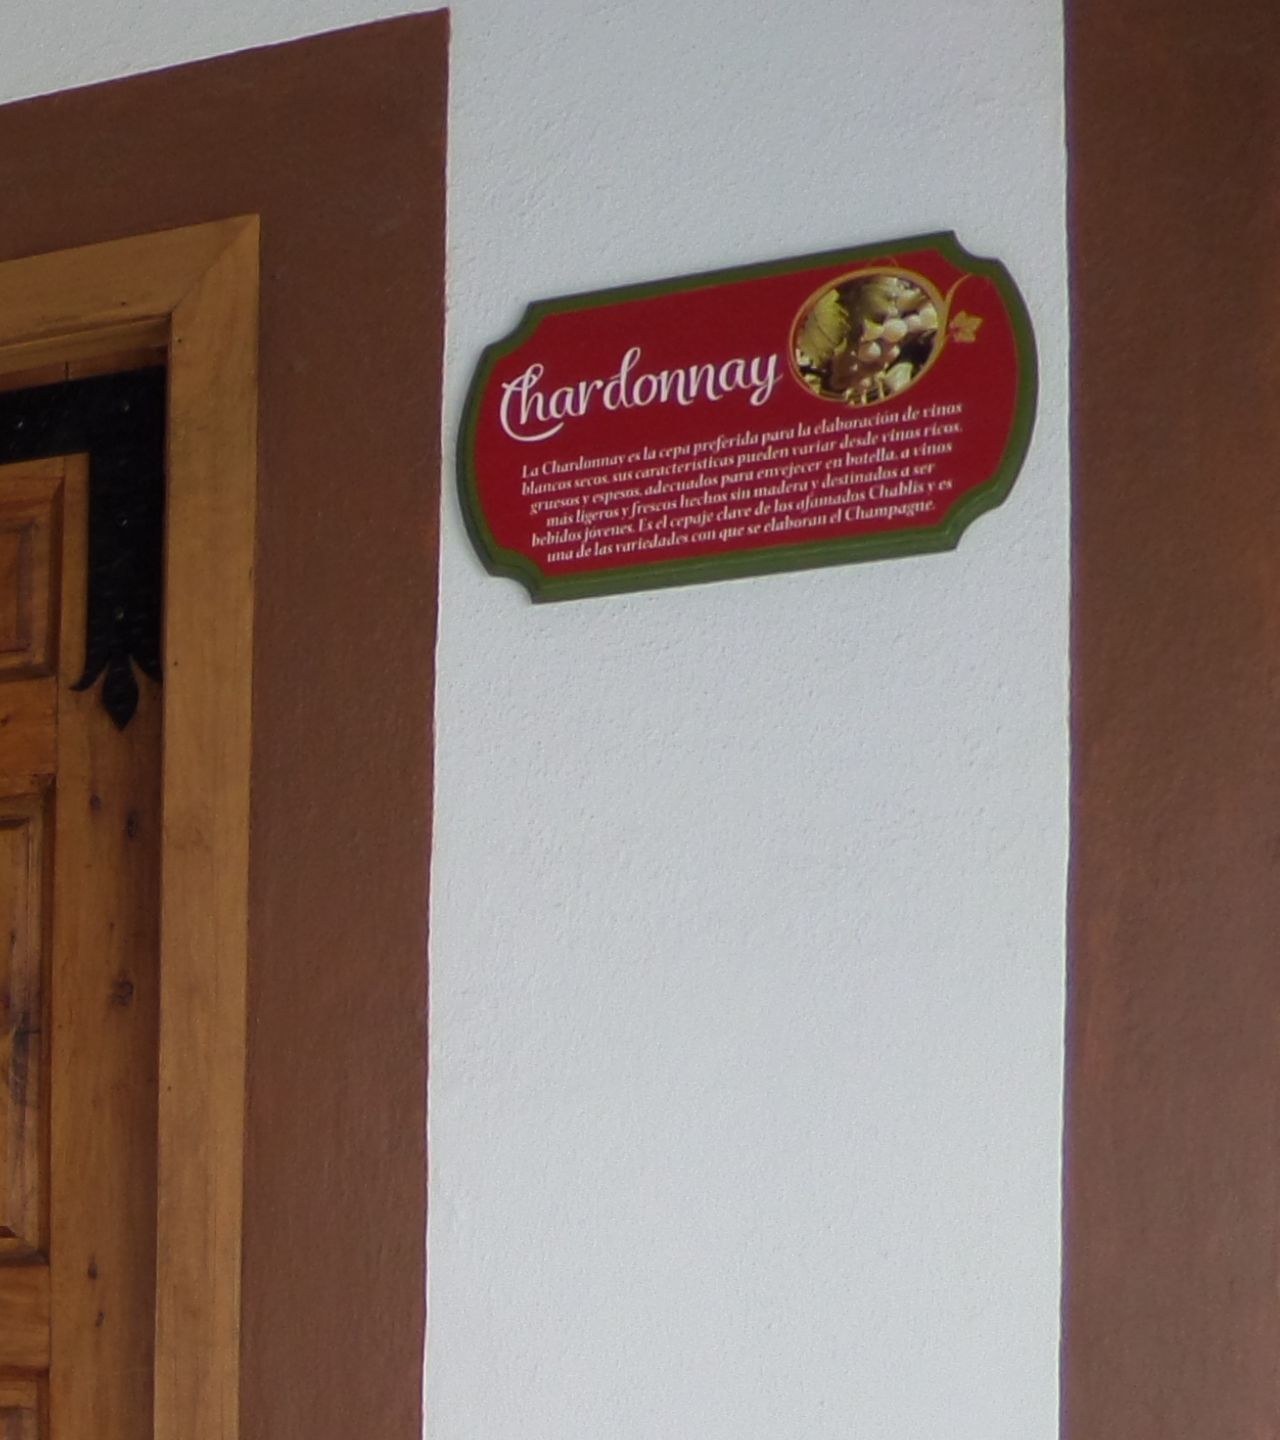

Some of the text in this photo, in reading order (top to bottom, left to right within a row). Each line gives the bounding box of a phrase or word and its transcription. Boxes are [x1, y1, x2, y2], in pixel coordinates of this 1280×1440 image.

[500, 346, 783, 441] Chardonnay
[521, 480, 572, 496] blancos
[612, 470, 633, 482] sus
[737, 445, 788, 467] pueden
[791, 440, 837, 456] variar
[839, 431, 878, 449] desde
[881, 427, 921, 443] vinos
[522, 403, 962, 478] La Chardonnay es la cepa preferida para la elaboración de vinos
[529, 497, 580, 516] gruesos
[644, 473, 718, 496] adecuados
[720, 470, 754, 488] para
[756, 460, 822, 479] envejecer
[825, 457, 842, 469] en
[913, 442, 952, 456] vinos
[532, 528, 582, 548] bebidos
[639, 517, 652, 533] Es
[655, 514, 667, 529] el
[670, 510, 713, 529] cepaje
[716, 505, 752, 521] clave
[754, 500, 771, 516] de
[774, 498, 793, 513] los
[796, 488, 865, 513] afamados
[868, 480, 924, 499] Chablis
[938, 478, 953, 490] es
[576, 508, 619, 525] ligeros
[629, 499, 677, 519] frescos
[680, 491, 731, 509] hechos
[731, 486, 750, 501] sin
[754, 480, 808, 497] madera
[821, 466, 897, 488] destinados
[913, 463, 935, 475] ser
[547, 548, 573, 563] una
[576, 542, 592, 559] de
[594, 541, 613, 556] las
[615, 531, 688, 553] variedades
[691, 530, 716, 543] con
[719, 525, 745, 542] que
[747, 522, 761, 535] se
[763, 515, 827, 533] elaboran
[830, 508, 842, 524] el
